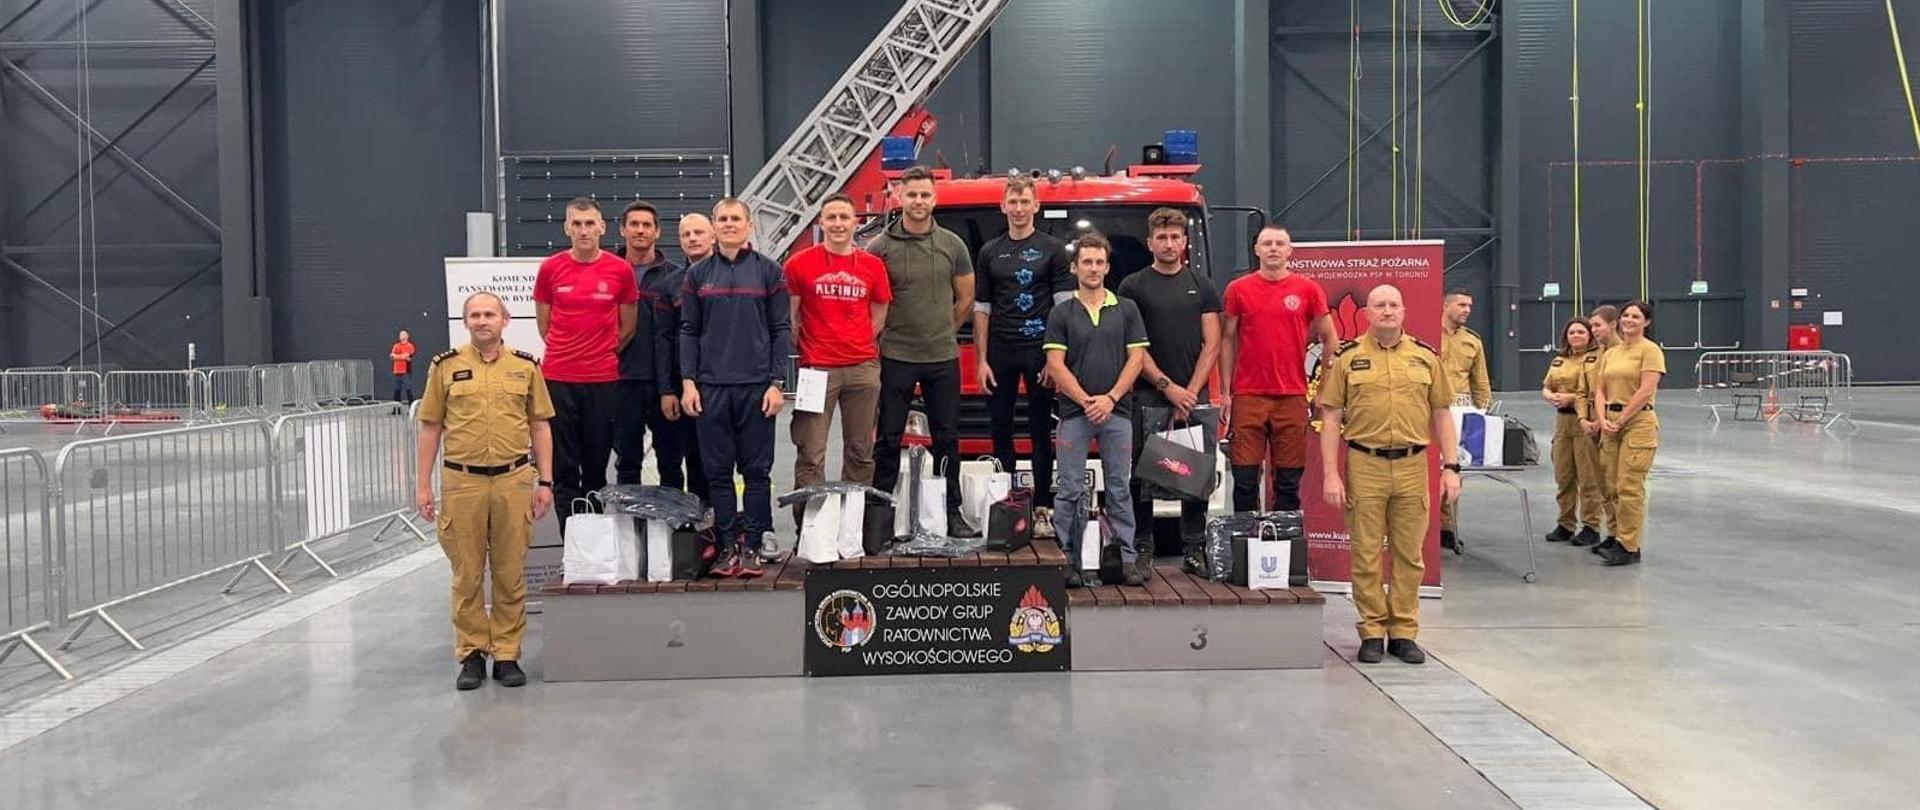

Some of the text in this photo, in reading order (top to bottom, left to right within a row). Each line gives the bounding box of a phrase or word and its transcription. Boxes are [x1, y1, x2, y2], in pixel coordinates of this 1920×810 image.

[1286, 256, 1430, 269] AŃSTWOWA STRAŻ POŻARNA
[492, 275, 536, 283] KOMEND
[1318, 271, 1368, 279] WOJEWÓDZKA
[1395, 270, 1429, 278] TORUNIU
[1308, 532, 1351, 541] www.kuja
[872, 579, 1001, 600] OGÓLNOPOLSKIE
[885, 604, 993, 621] ZAWODY GRUP
[884, 627, 992, 642] RATOWNICTWA
[1189, 624, 1208, 651] 3
[862, 647, 1013, 665] WYSOKOŚCIOWEGO
